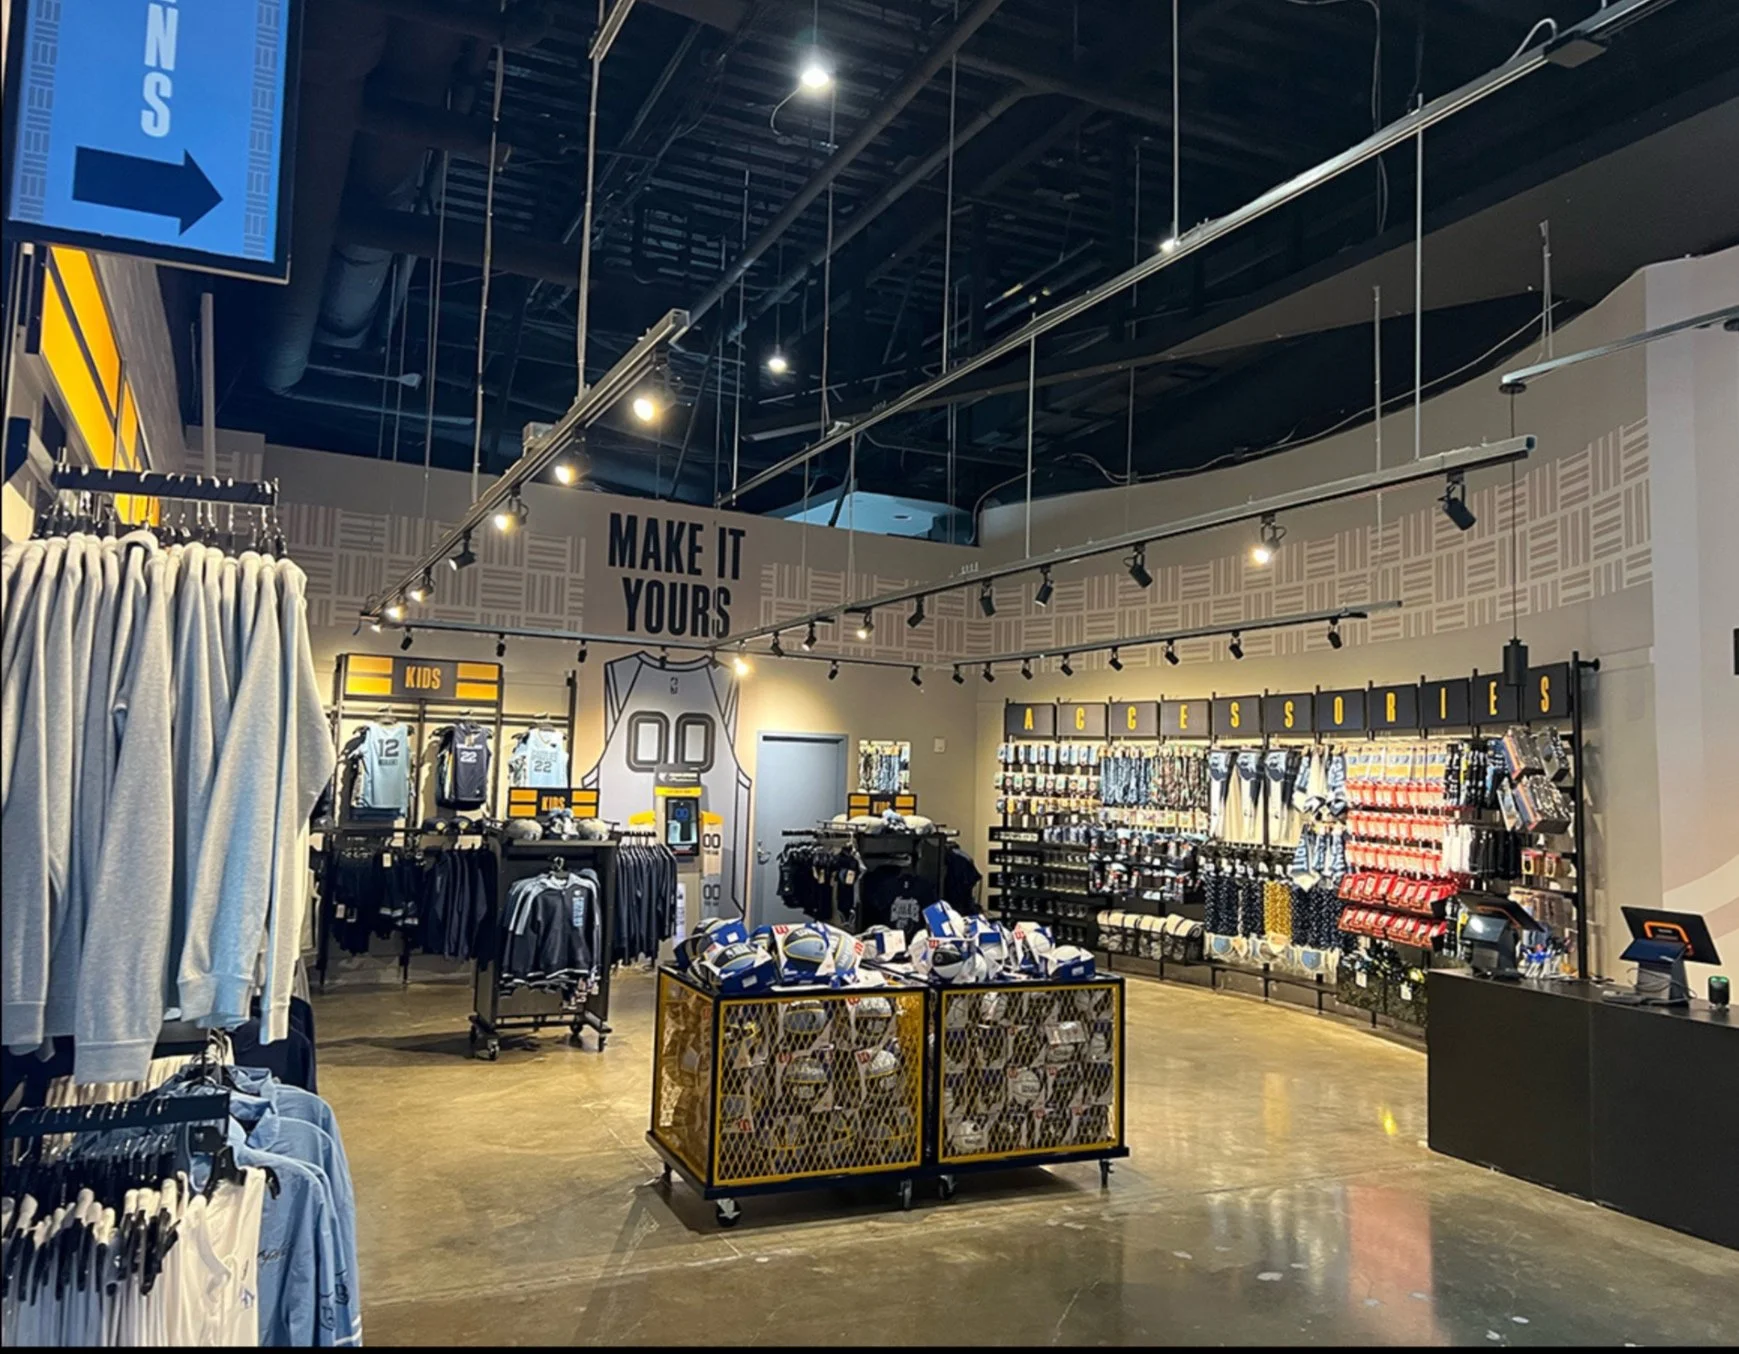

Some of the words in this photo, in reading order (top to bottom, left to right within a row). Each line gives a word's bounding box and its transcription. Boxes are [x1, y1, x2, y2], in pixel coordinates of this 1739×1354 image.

[140, 0, 179, 137] NS
[608, 512, 704, 576] MAKE
[717, 526, 746, 580] IT
[621, 576, 732, 639] YOURS
[404, 665, 441, 690] KIDS
[1023, 675, 1550, 731] ACCESSORIES
[377, 738, 399, 758] 12
[626, 710, 716, 774] 00
[460, 751, 478, 763] 22
[533, 760, 552, 773] 22
[541, 796, 566, 811] KIDS
[702, 833, 721, 849] 00
[703, 884, 721, 900] 00
